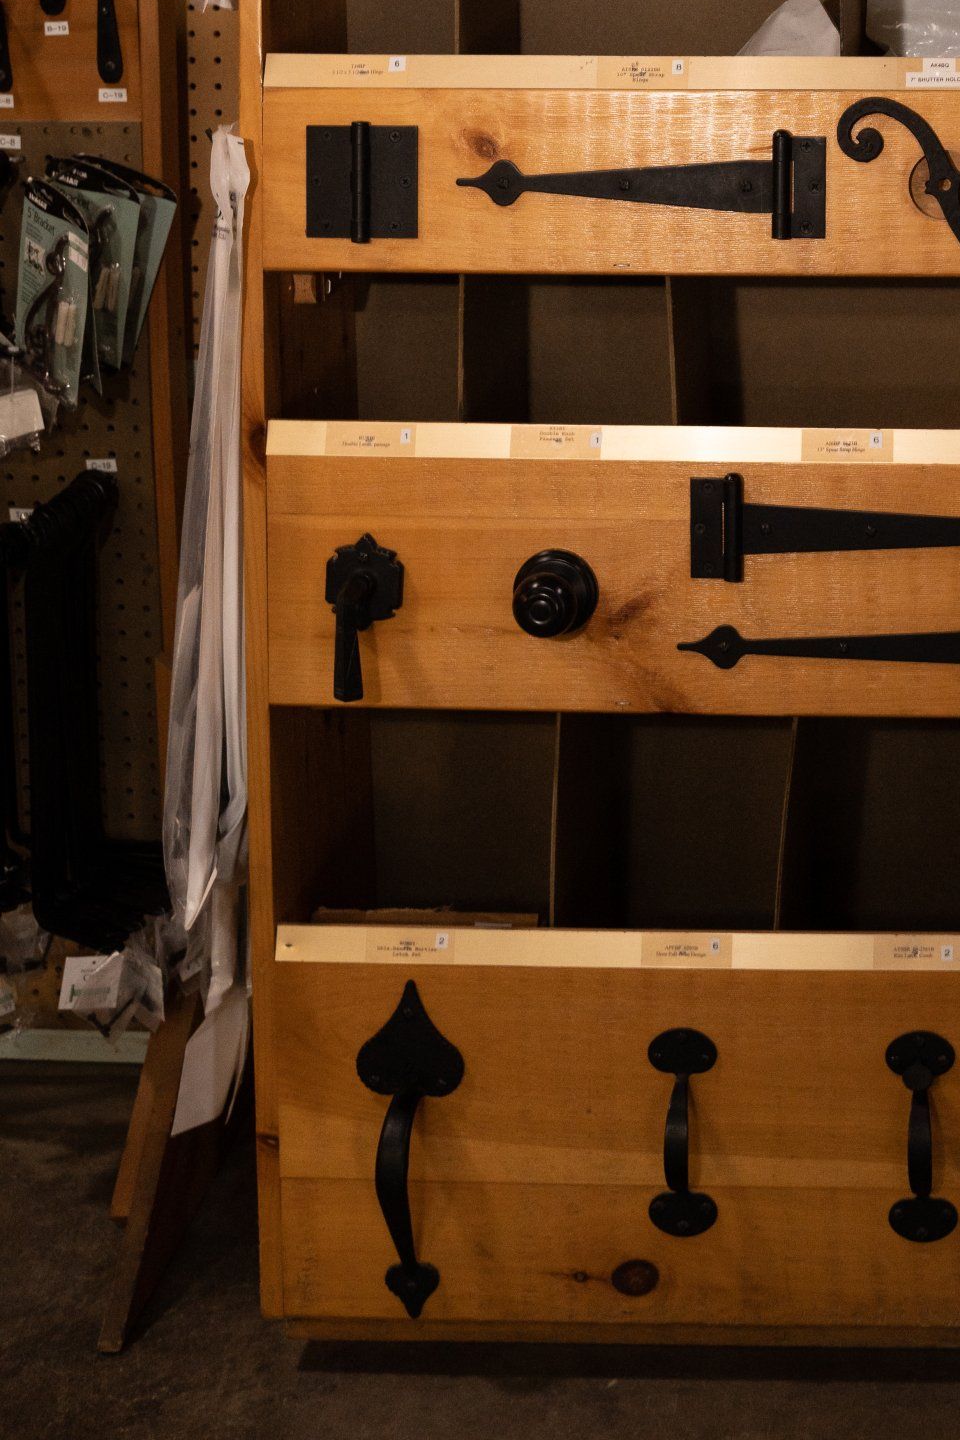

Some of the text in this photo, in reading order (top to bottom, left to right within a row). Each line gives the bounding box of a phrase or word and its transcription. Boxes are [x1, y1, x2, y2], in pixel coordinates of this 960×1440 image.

[394, 60, 400, 68] 6
[873, 436, 879, 444] 6
[439, 937, 445, 945] 2
[712, 942, 719, 950] 6
[944, 949, 950, 957] 2
